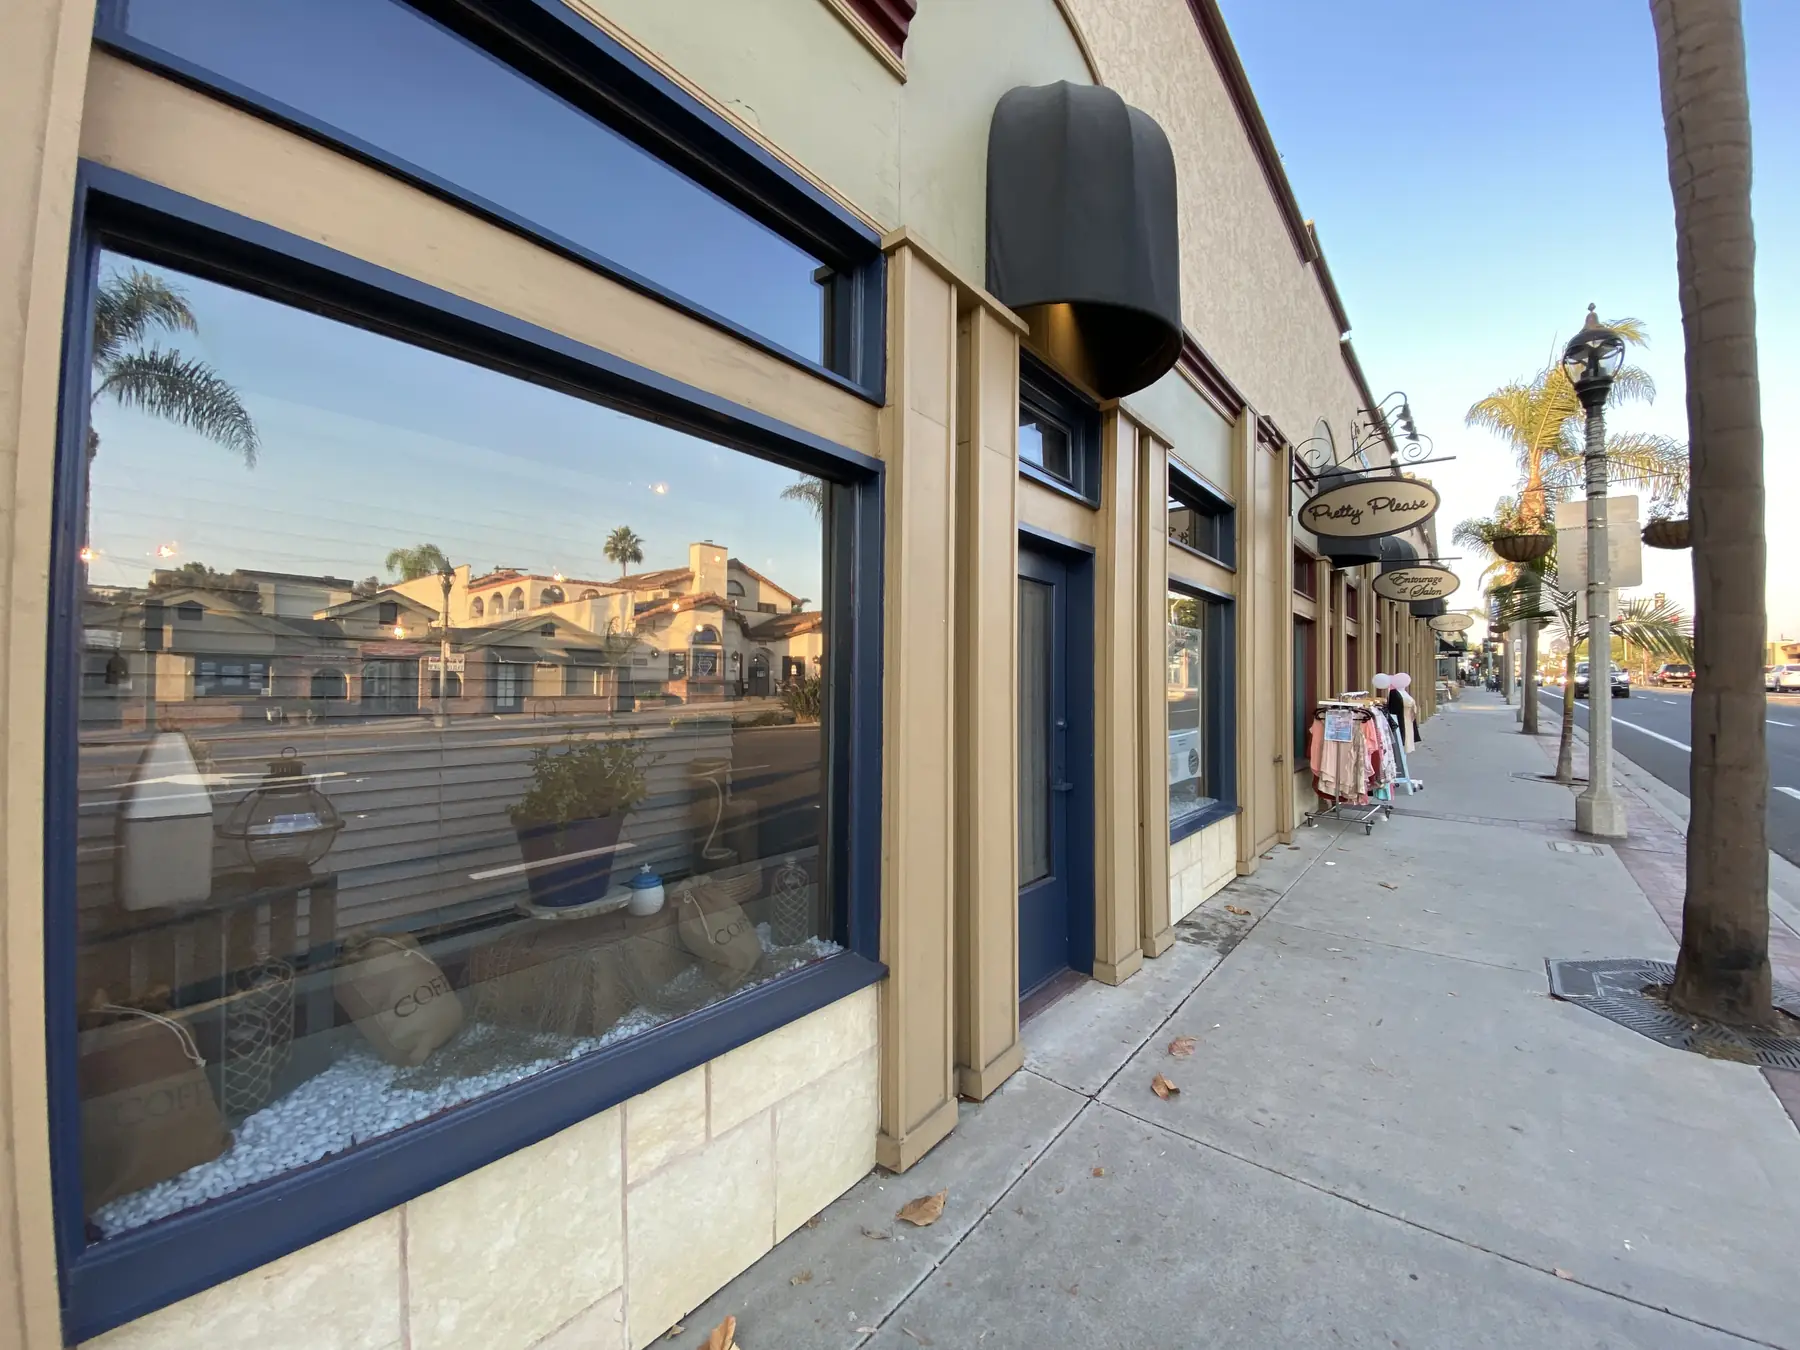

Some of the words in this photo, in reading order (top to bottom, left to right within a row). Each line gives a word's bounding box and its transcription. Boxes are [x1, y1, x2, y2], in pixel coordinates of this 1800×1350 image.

[1308, 504, 1363, 525] Pretty
[1367, 496, 1428, 516] Please
[1389, 572, 1443, 586] Entourage
[1410, 583, 1442, 599] Salon
